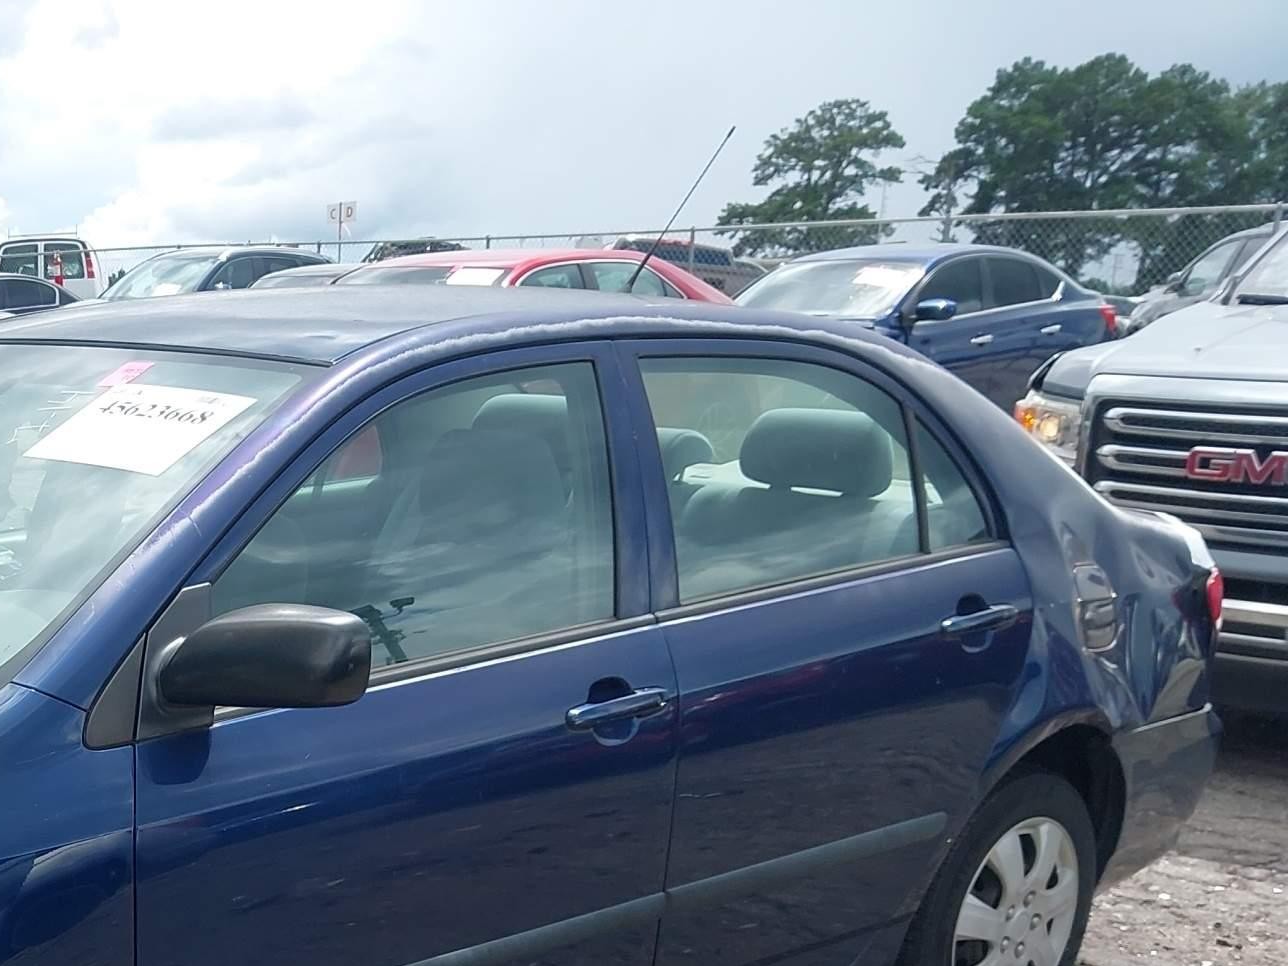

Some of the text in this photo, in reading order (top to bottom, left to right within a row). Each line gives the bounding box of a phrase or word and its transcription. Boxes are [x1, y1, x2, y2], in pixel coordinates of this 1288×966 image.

[330, 208, 337, 220] C
[345, 206, 353, 218] D
[99, 400, 214, 425] 45623668
[1185, 445, 1288, 486] GM
